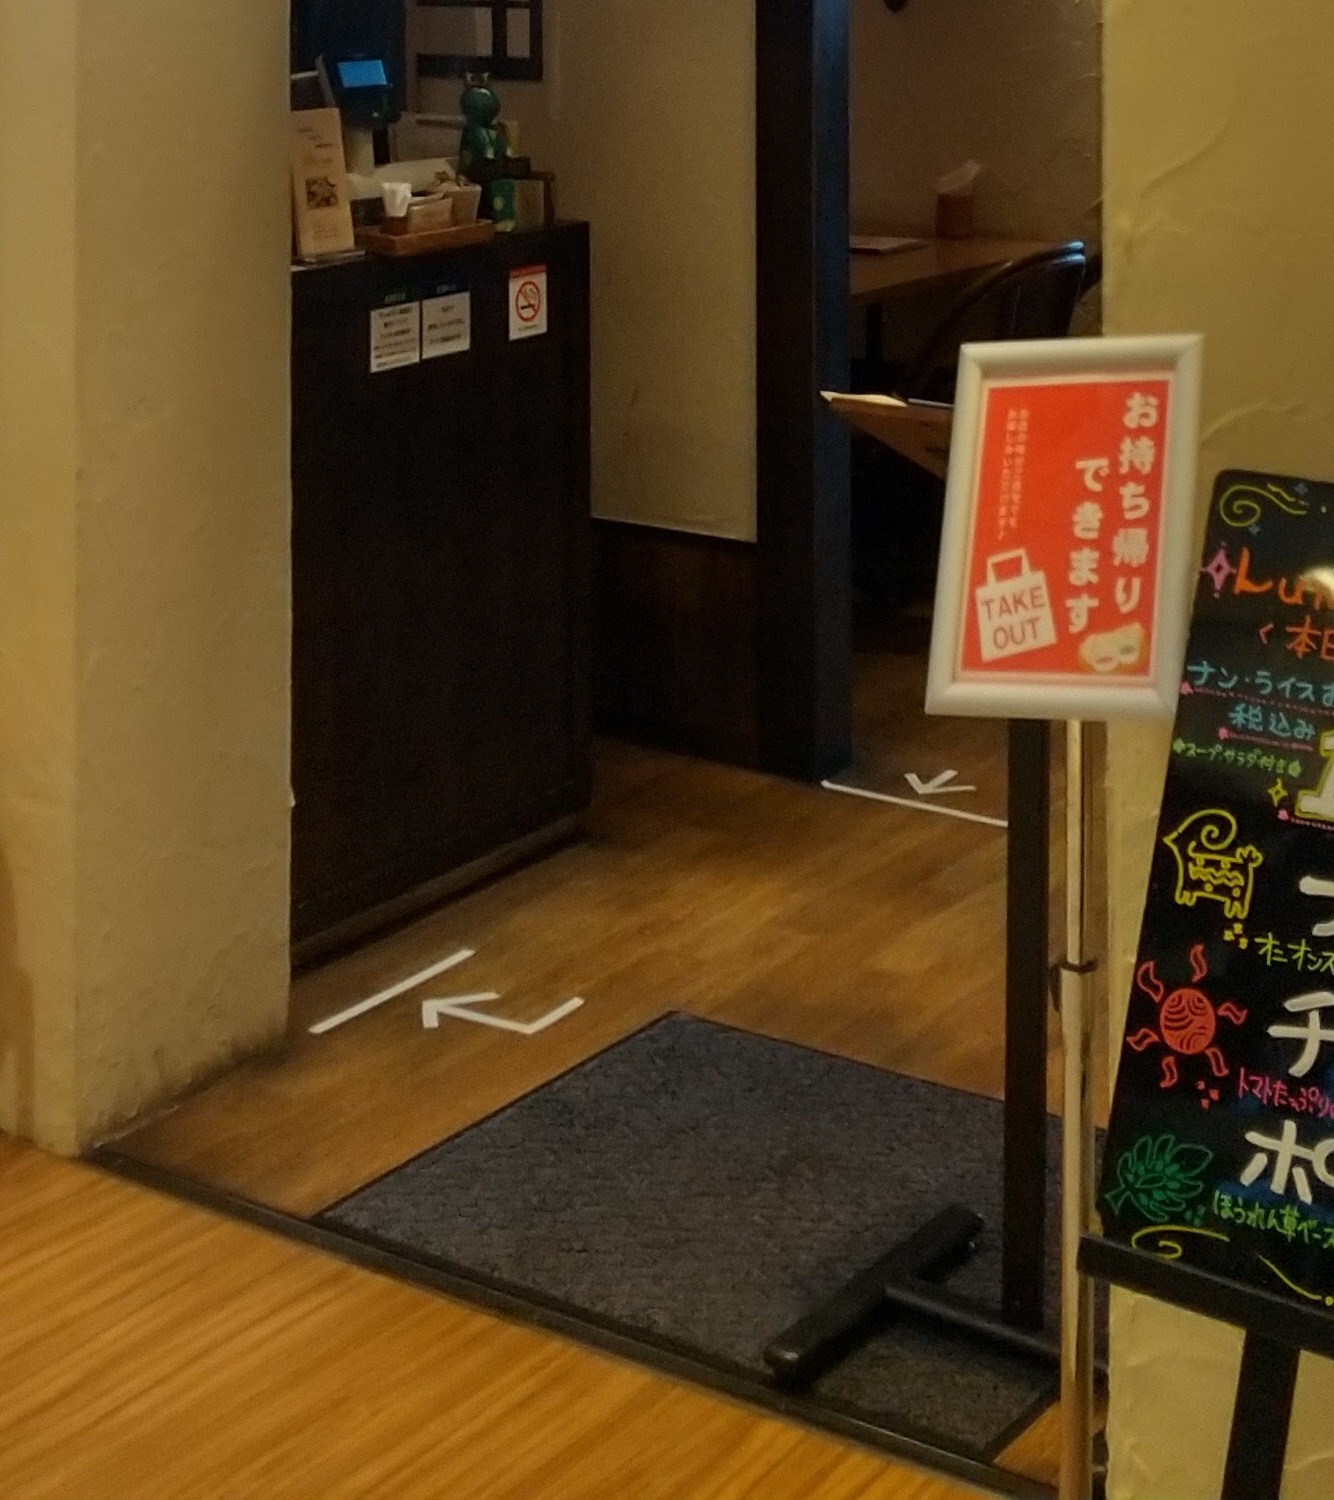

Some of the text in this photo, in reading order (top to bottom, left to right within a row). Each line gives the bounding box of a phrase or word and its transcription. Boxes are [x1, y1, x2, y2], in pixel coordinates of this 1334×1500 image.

[1112, 392, 1160, 614] お持ち帰り
[1066, 456, 1110, 635] できます
[980, 585, 1047, 622] TAKE
[992, 616, 1042, 651] OUT
[1228, 702, 1317, 741] 税込み
